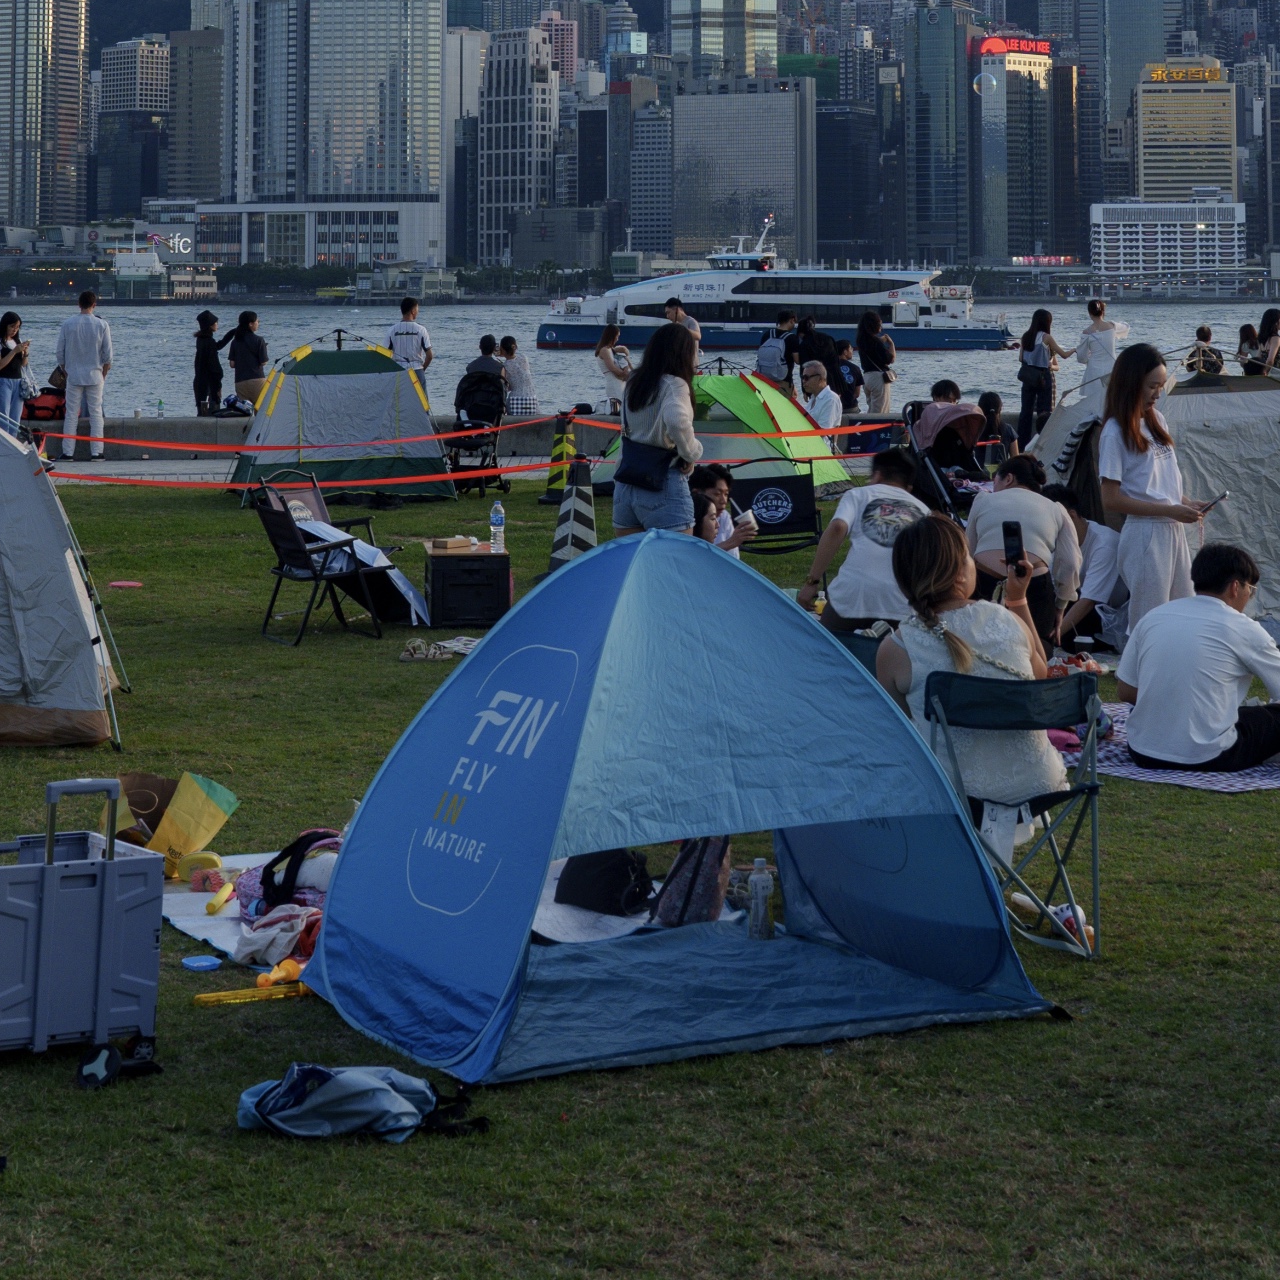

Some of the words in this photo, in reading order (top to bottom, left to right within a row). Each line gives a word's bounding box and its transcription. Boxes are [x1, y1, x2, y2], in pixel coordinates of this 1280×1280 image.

[1006, 39, 1019, 50] LEE
[1020, 40, 1036, 52] KUM
[1037, 41, 1050, 53] KEE
[1151, 68, 1220, 81] 永安百貨
[169, 233, 191, 253] ifc
[752, 500, 792, 511] BUTCHERS
[467, 690, 559, 759] FIN
[448, 757, 497, 793] FLY
[433, 791, 466, 825] IN
[422, 827, 486, 862] NATURE
